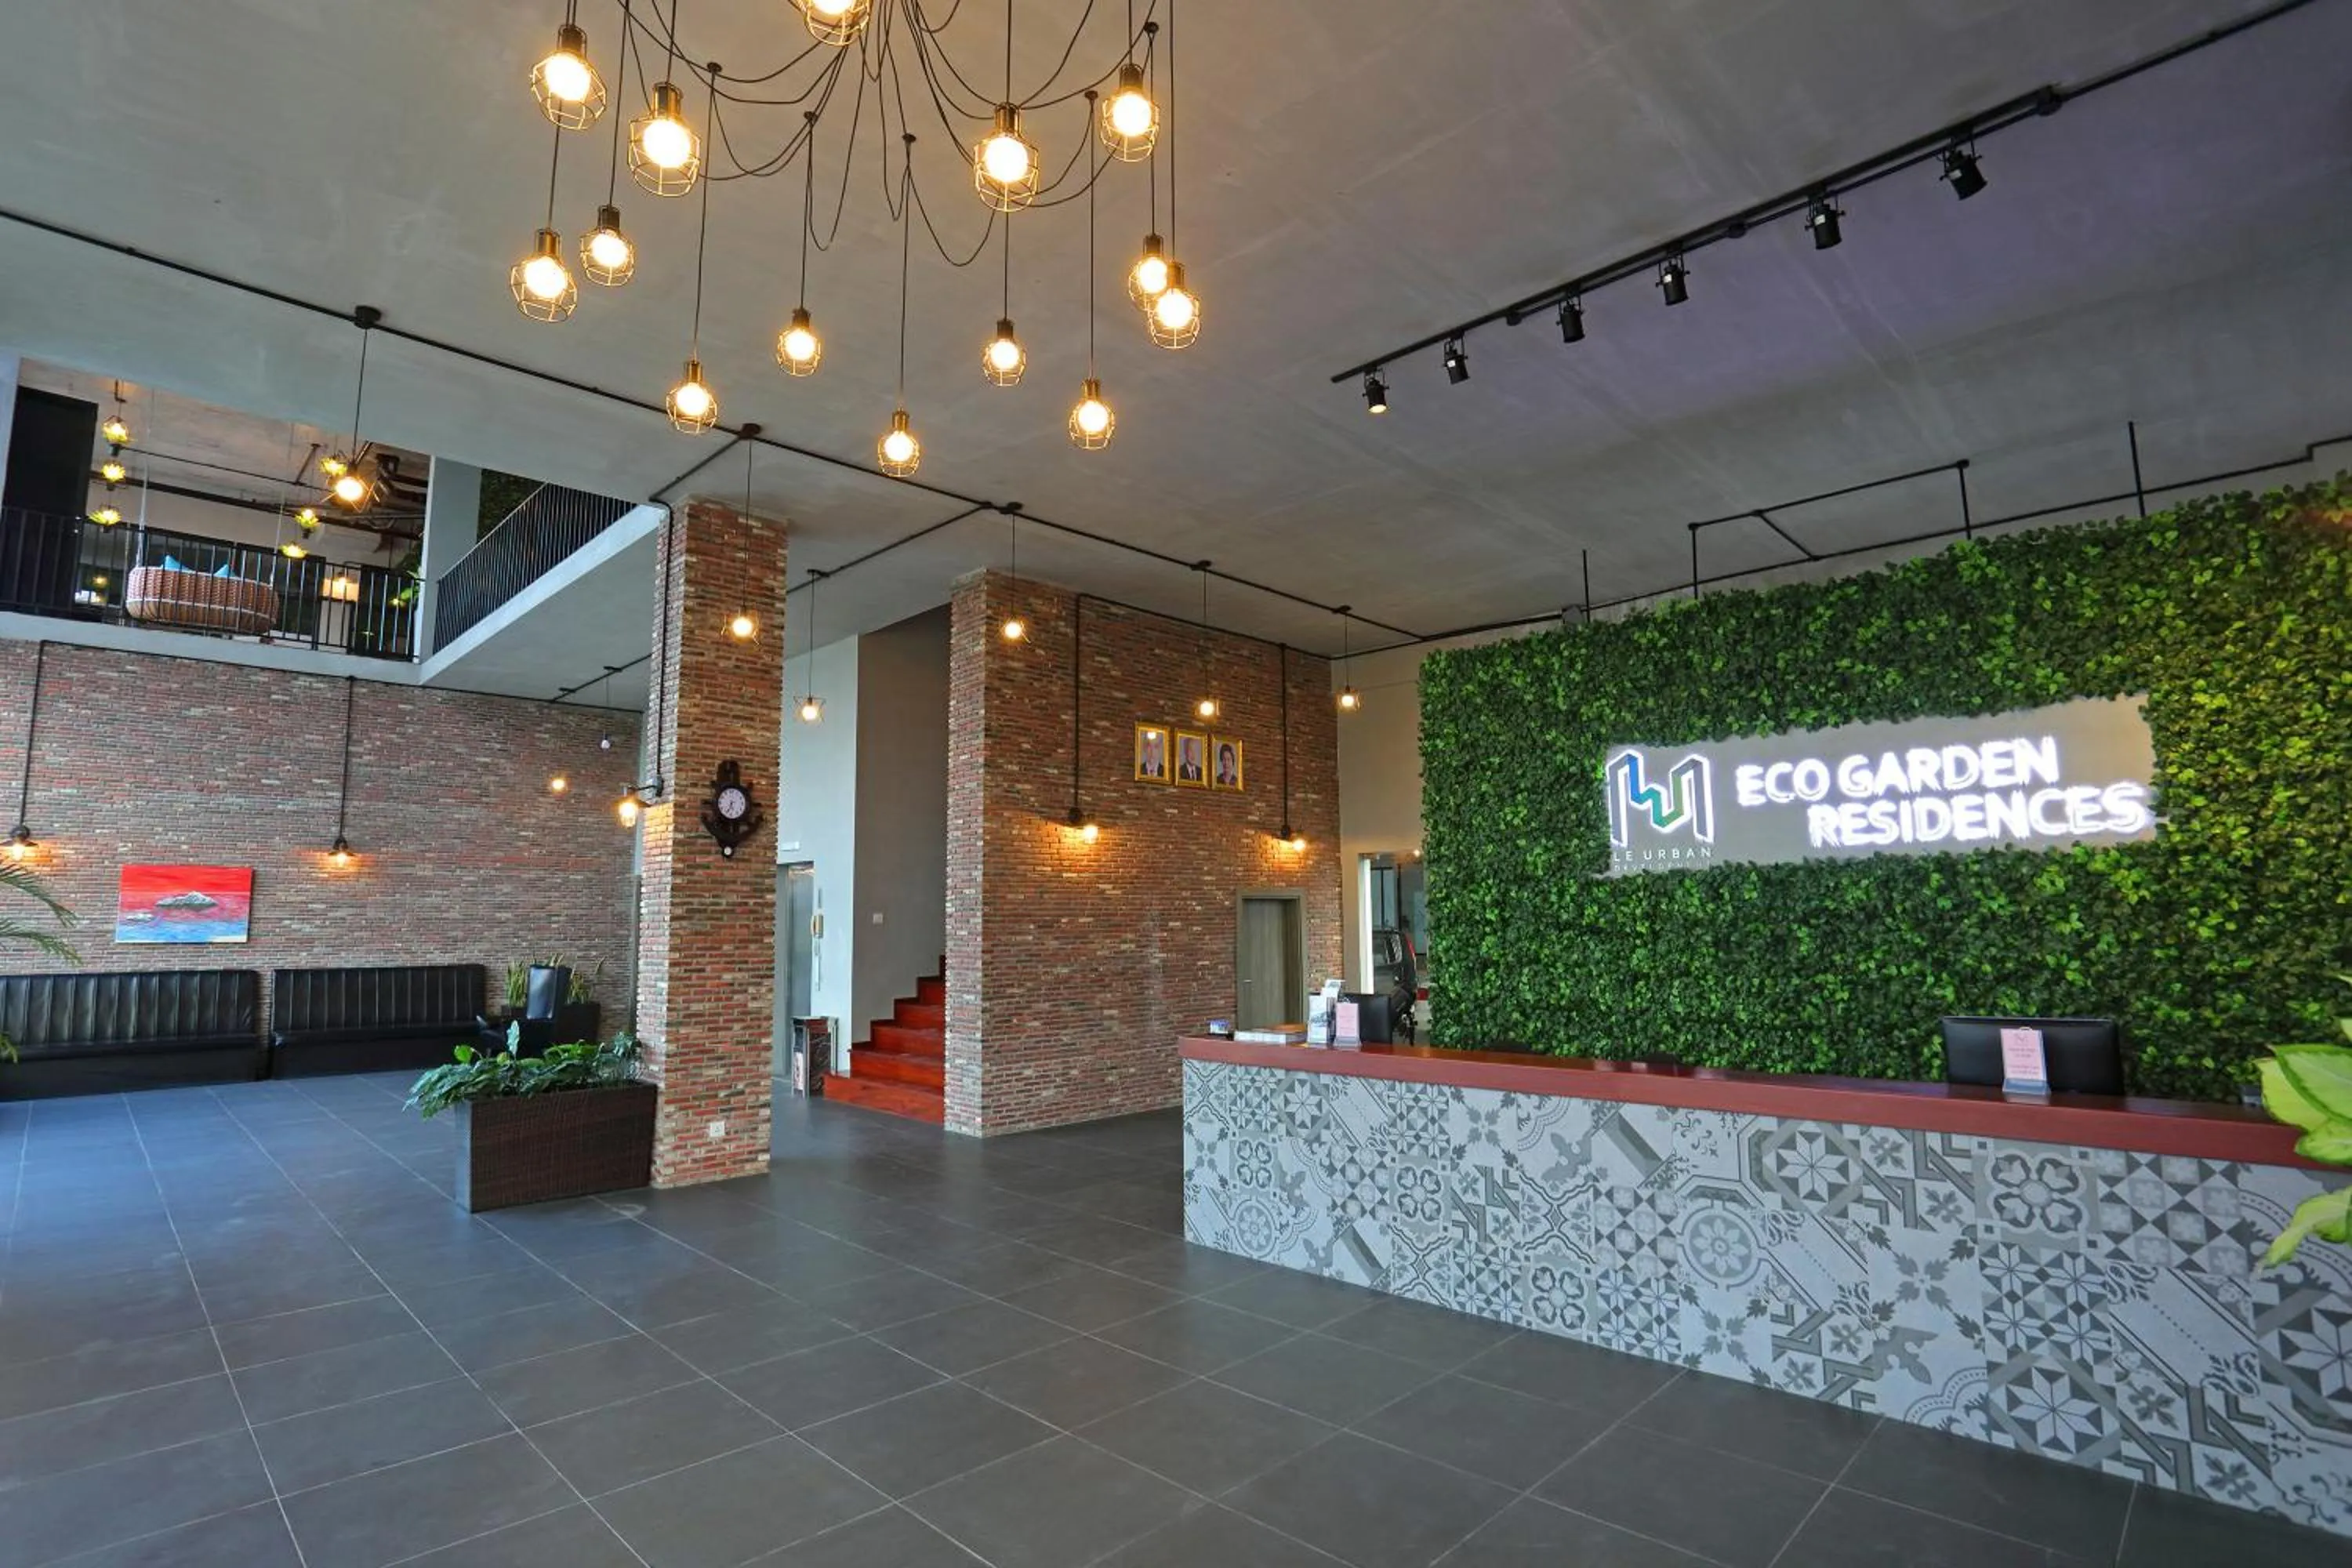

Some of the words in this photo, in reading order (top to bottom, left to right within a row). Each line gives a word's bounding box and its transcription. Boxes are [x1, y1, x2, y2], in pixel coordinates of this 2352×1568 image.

[1735, 758, 1831, 807] ECO
[1837, 735, 2060, 798] GARDEN
[1807, 781, 2147, 848] RESIDENCES
[1613, 851, 1633, 862] LE
[1643, 847, 1711, 861] URBAN
